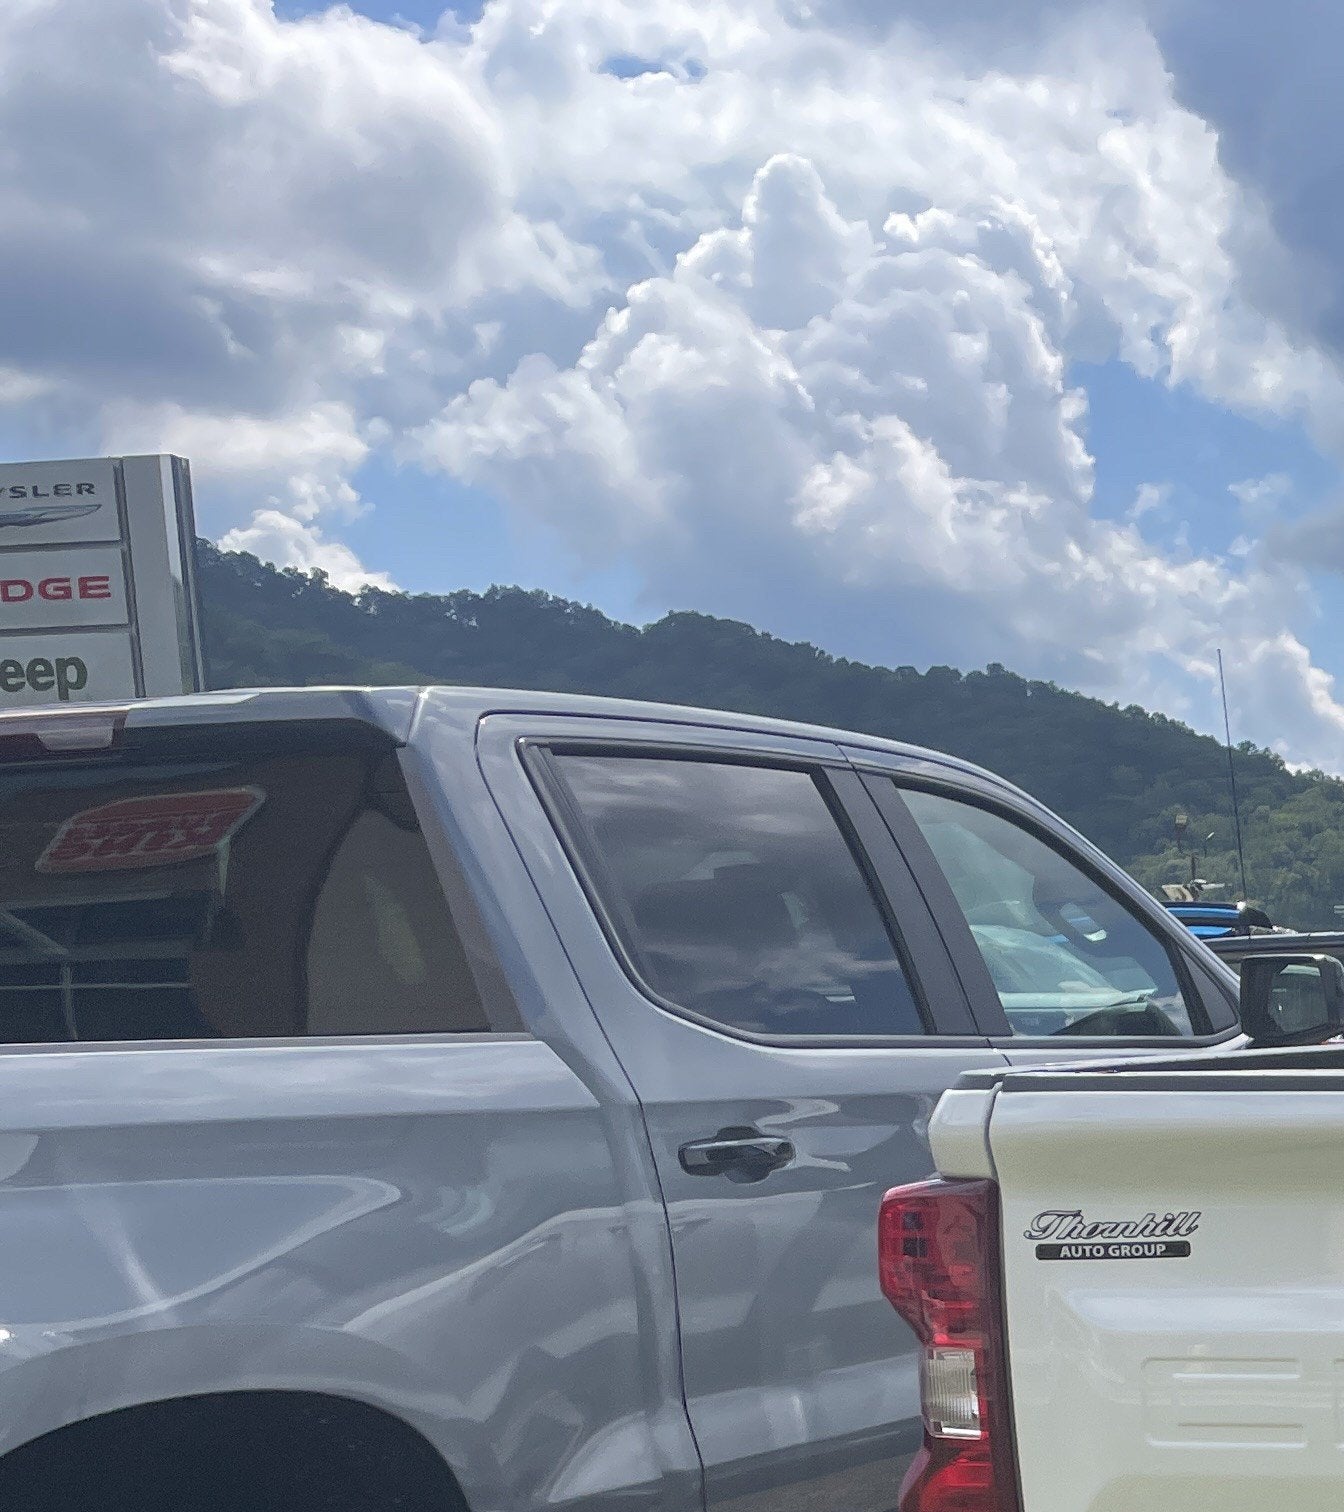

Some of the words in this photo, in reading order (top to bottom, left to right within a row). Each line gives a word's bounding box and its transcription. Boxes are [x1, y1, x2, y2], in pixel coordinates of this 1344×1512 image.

[0, 483, 95, 499] SLER
[1023, 1209, 1201, 1240] Thornhill
[1060, 1245, 1104, 1258] AUTO
[1107, 1243, 1166, 1257] GROUP
